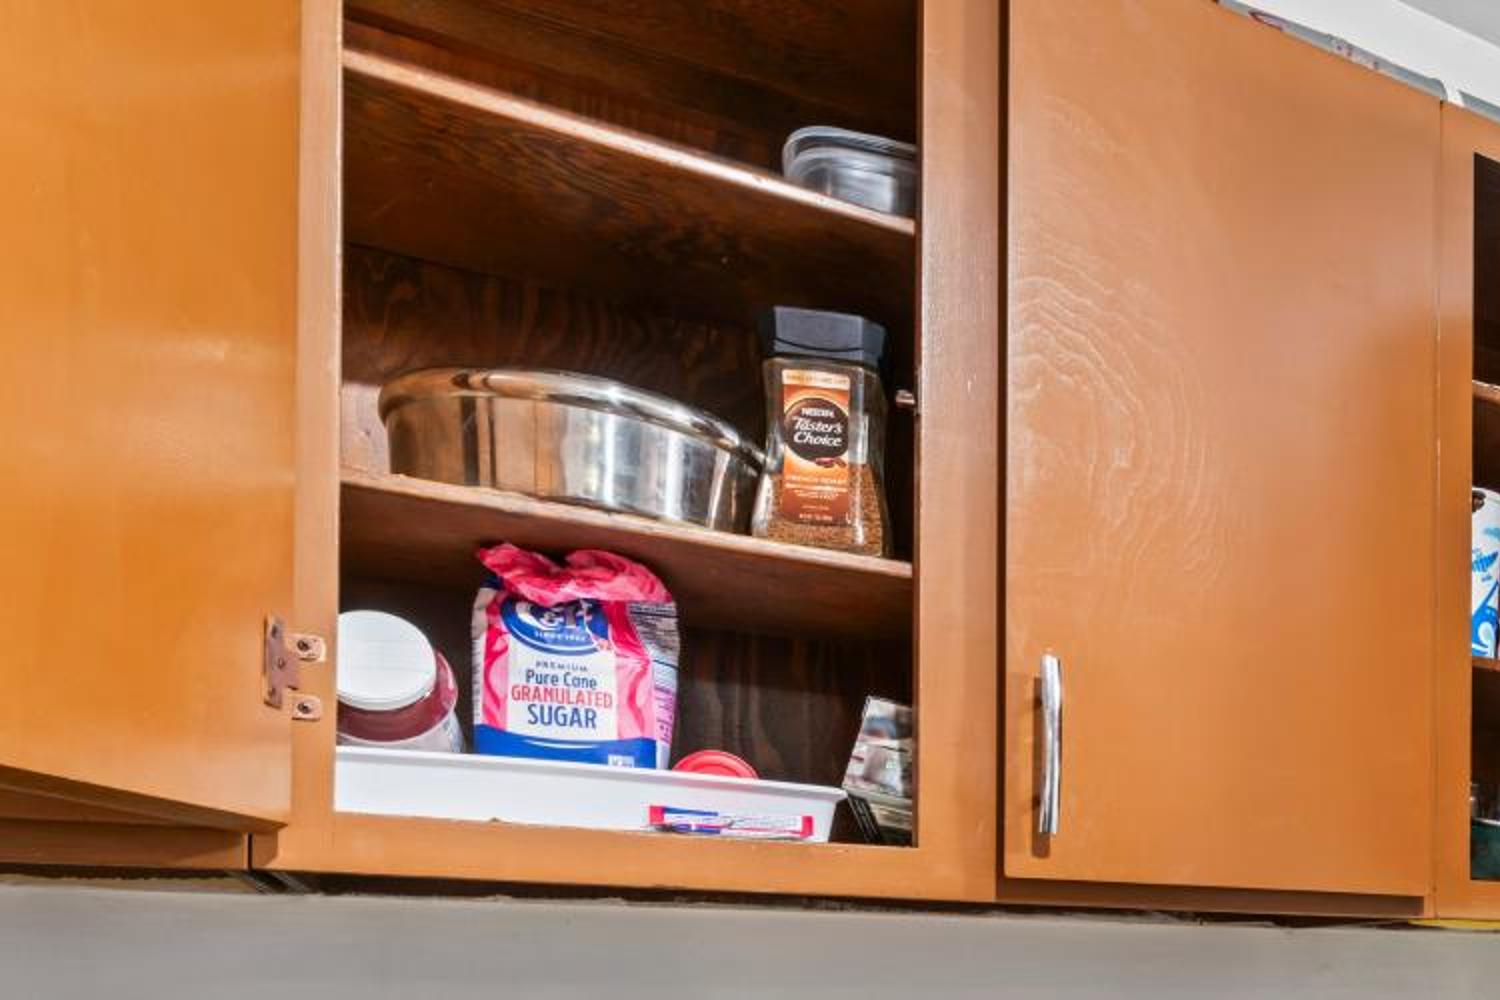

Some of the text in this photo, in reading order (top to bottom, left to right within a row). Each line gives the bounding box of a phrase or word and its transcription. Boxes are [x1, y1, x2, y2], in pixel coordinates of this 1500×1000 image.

[792, 416, 843, 434] Taster's
[793, 431, 842, 447] Choice
[536, 661, 588, 672] PREMIUM
[526, 669, 597, 690] Pure Cane
[511, 685, 613, 708] GRANULATED
[527, 704, 597, 728] SUGAR
